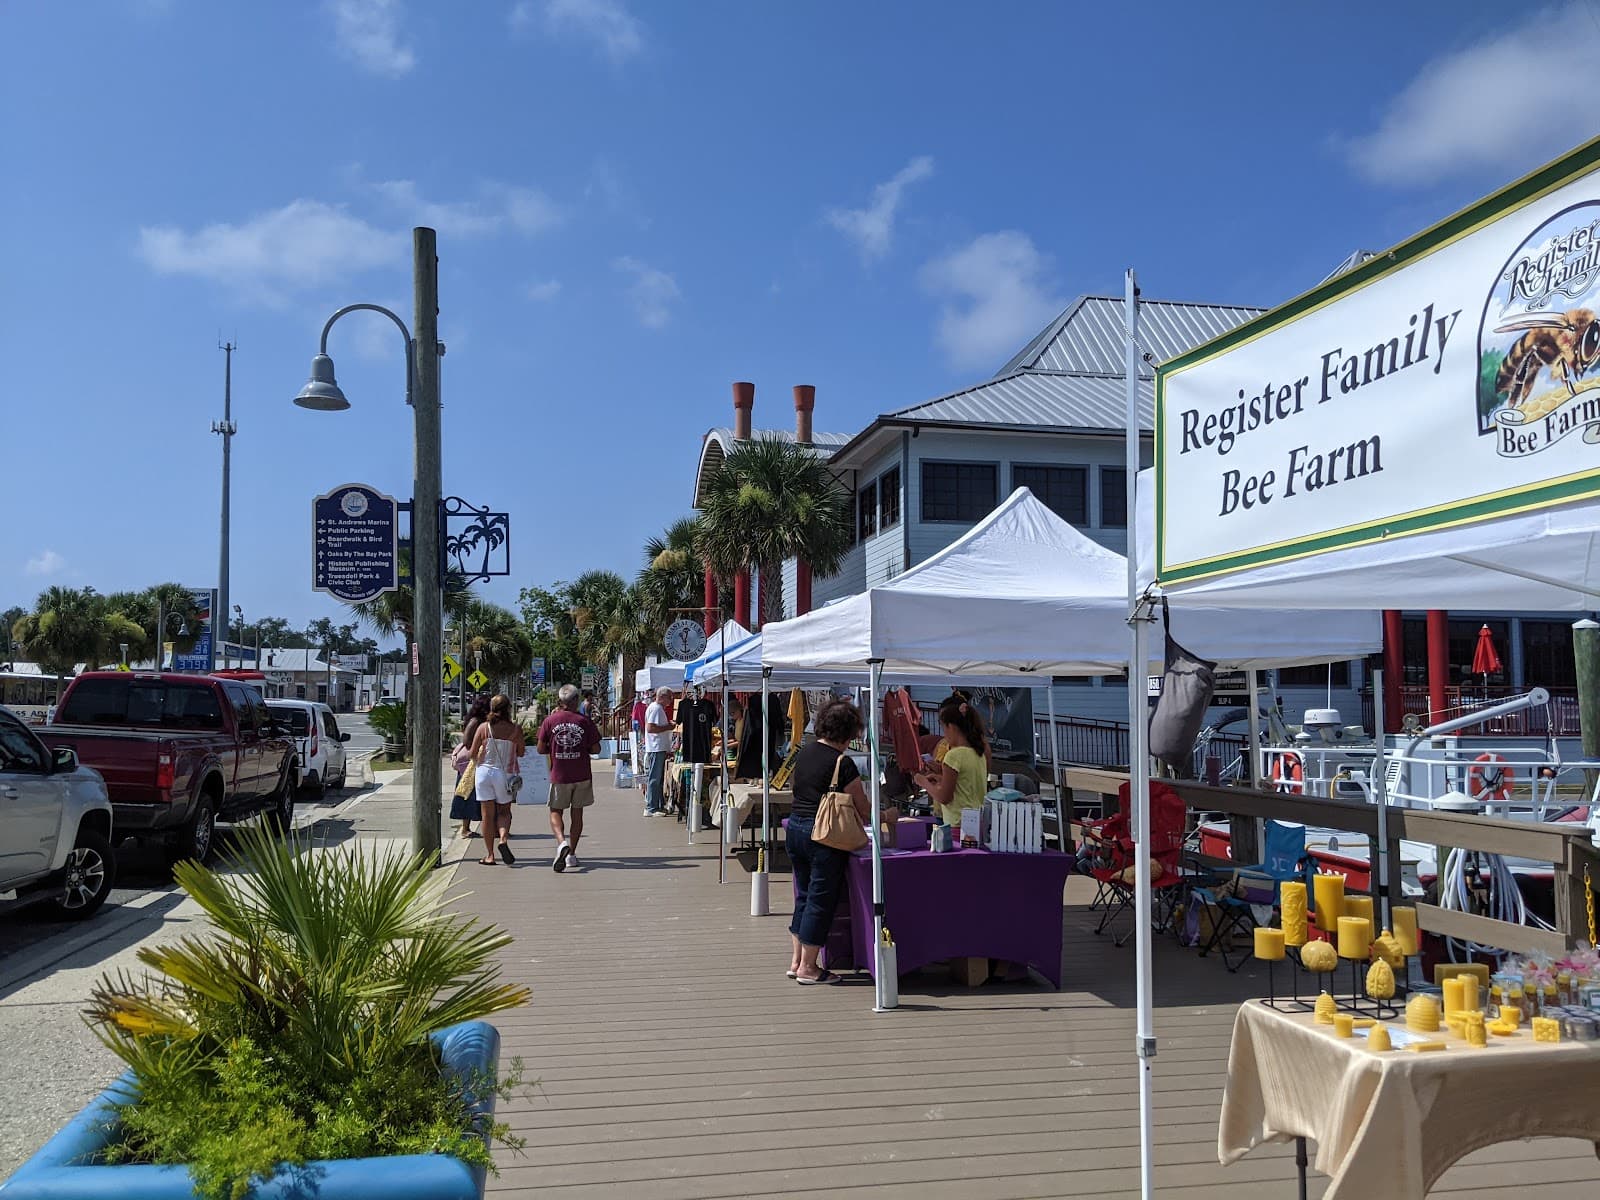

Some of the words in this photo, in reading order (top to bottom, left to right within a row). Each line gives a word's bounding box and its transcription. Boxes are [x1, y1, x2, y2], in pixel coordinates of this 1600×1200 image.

[1180, 375, 1309, 456] Register
[1318, 303, 1463, 405] Family
[1218, 469, 1276, 517] Bee
[1283, 434, 1384, 499] Farm
[1502, 427, 1538, 454] Bee
